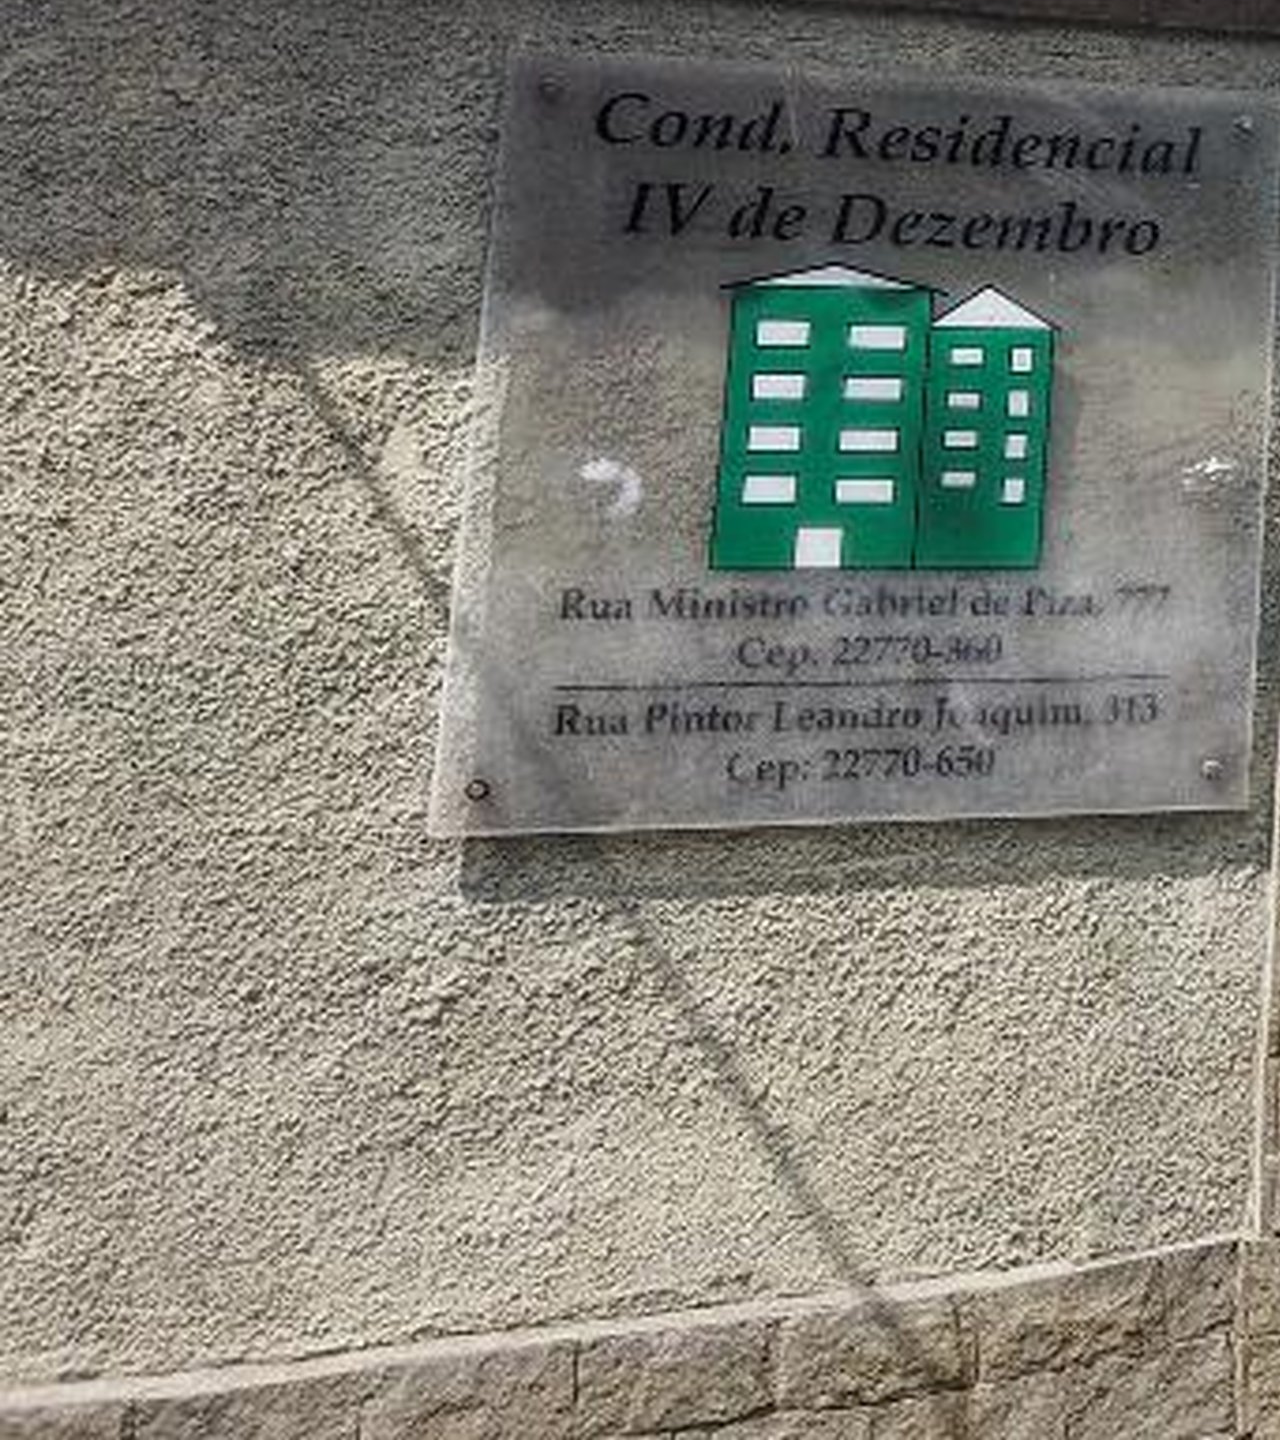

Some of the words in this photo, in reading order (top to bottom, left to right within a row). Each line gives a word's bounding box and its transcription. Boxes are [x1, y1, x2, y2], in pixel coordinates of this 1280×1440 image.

[595, 92, 792, 154] Cond.
[815, 107, 1201, 175] Residencial
[623, 182, 715, 236] IV
[726, 186, 806, 241] de
[830, 193, 1161, 256] Dezembro
[559, 588, 633, 621] Rua
[650, 589, 808, 620] Ministro
[824, 588, 958, 617] Gabriel
[970, 590, 1010, 617] de
[555, 704, 629, 736] Rua
[645, 702, 758, 734] Pintor
[774, 700, 922, 733] Leandro
